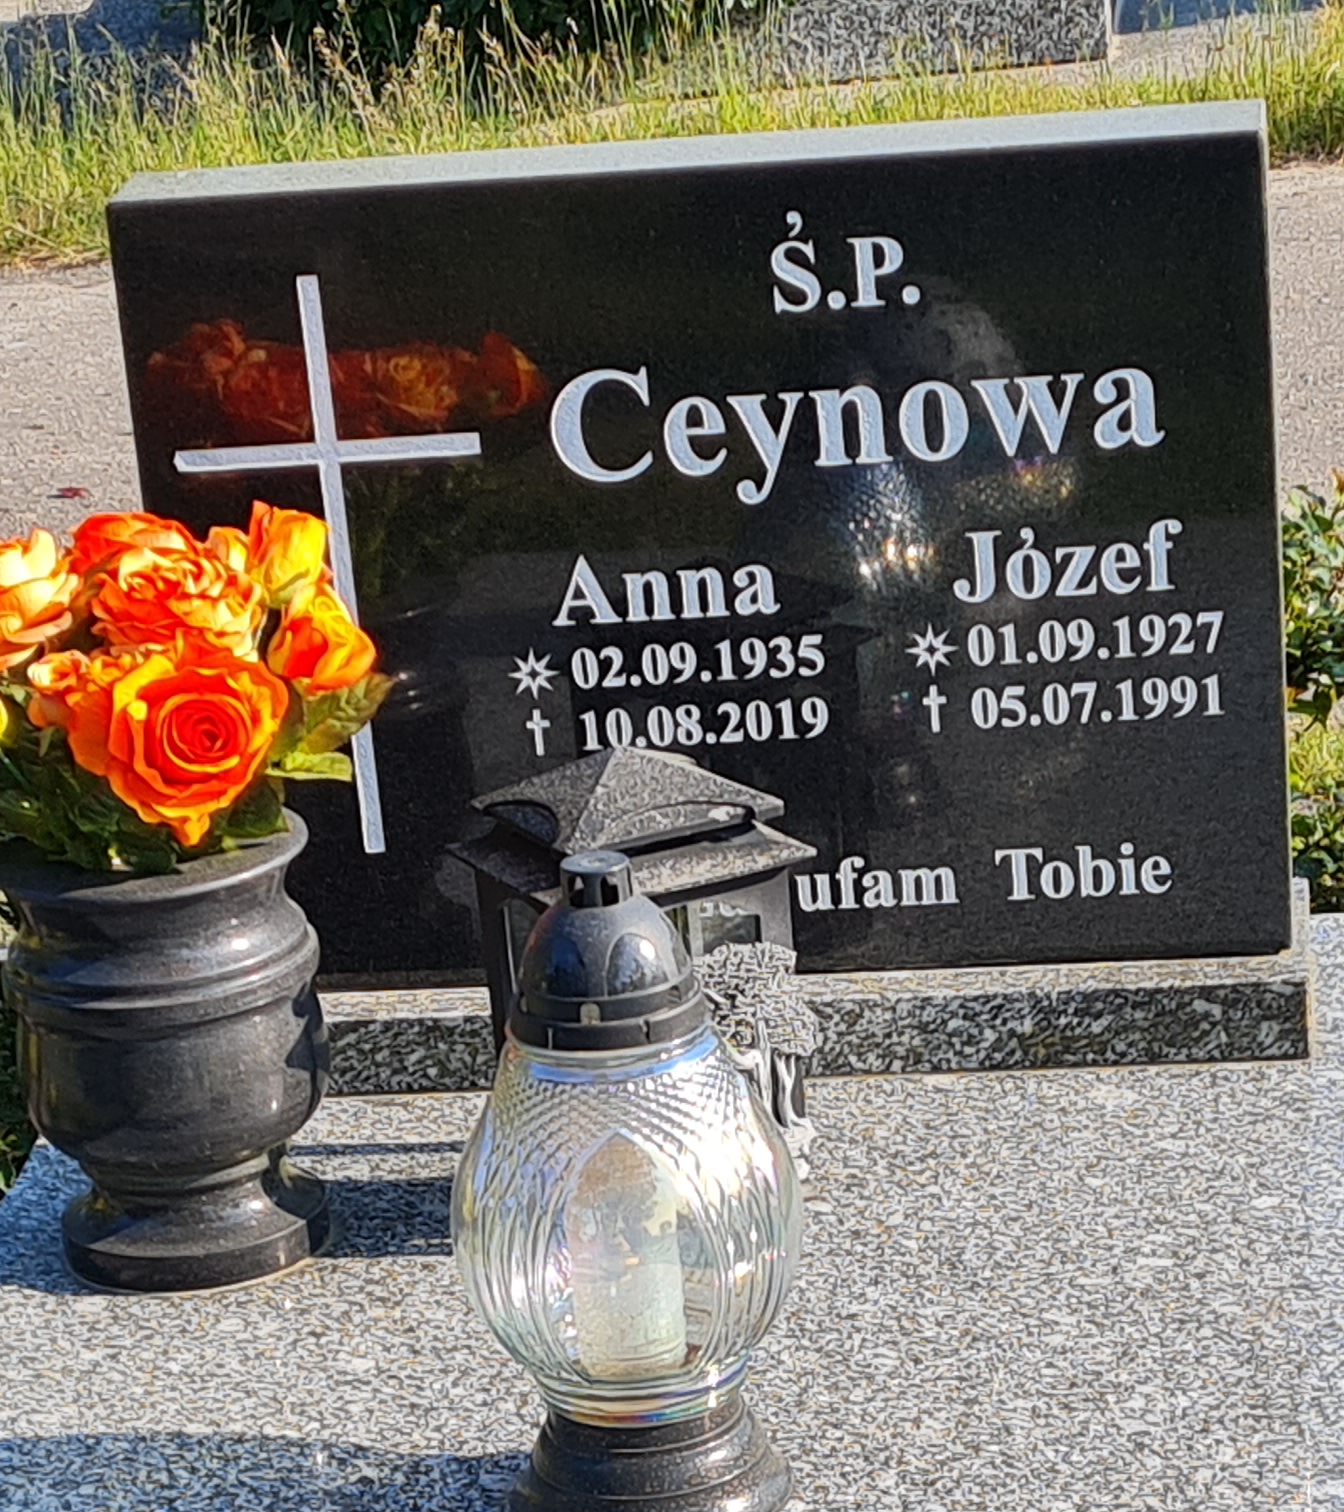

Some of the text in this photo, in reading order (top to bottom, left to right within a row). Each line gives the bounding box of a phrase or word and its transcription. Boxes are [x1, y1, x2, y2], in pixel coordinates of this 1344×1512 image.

[770, 210, 922, 314] Ś.P.
[550, 366, 1167, 505] Ceynowa
[552, 554, 781, 627] Anna
[952, 519, 1184, 604] Józef
[570, 633, 826, 690] 02.09.1935
[967, 610, 1226, 667] 01.09.1927
[579, 696, 830, 752] 10.08.2019
[971, 673, 1226, 730] 05.07.1991
[794, 842, 1174, 913] ufam Tobie
